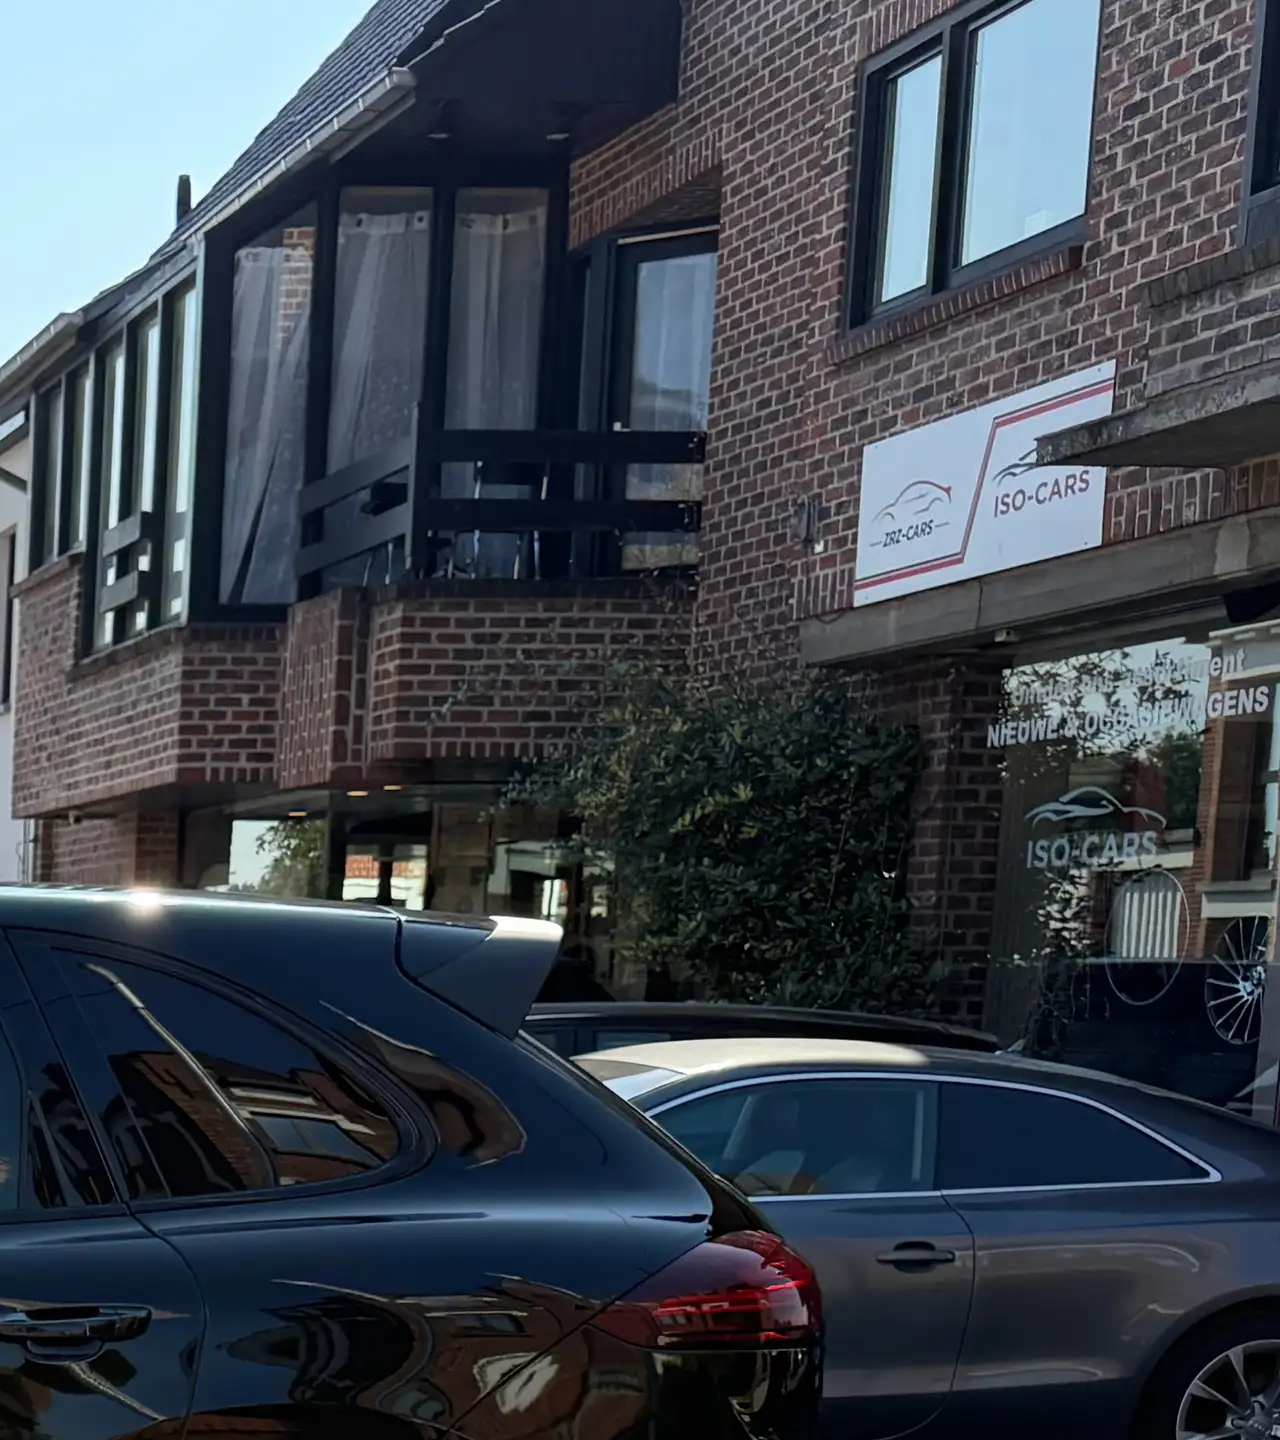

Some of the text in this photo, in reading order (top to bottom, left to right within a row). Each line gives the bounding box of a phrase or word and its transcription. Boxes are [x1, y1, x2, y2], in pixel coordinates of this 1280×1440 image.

[994, 470, 1090, 518] ISO-CARS
[882, 520, 933, 548] ZRZ-CARS
[1026, 830, 1158, 869] ISO-CARS
